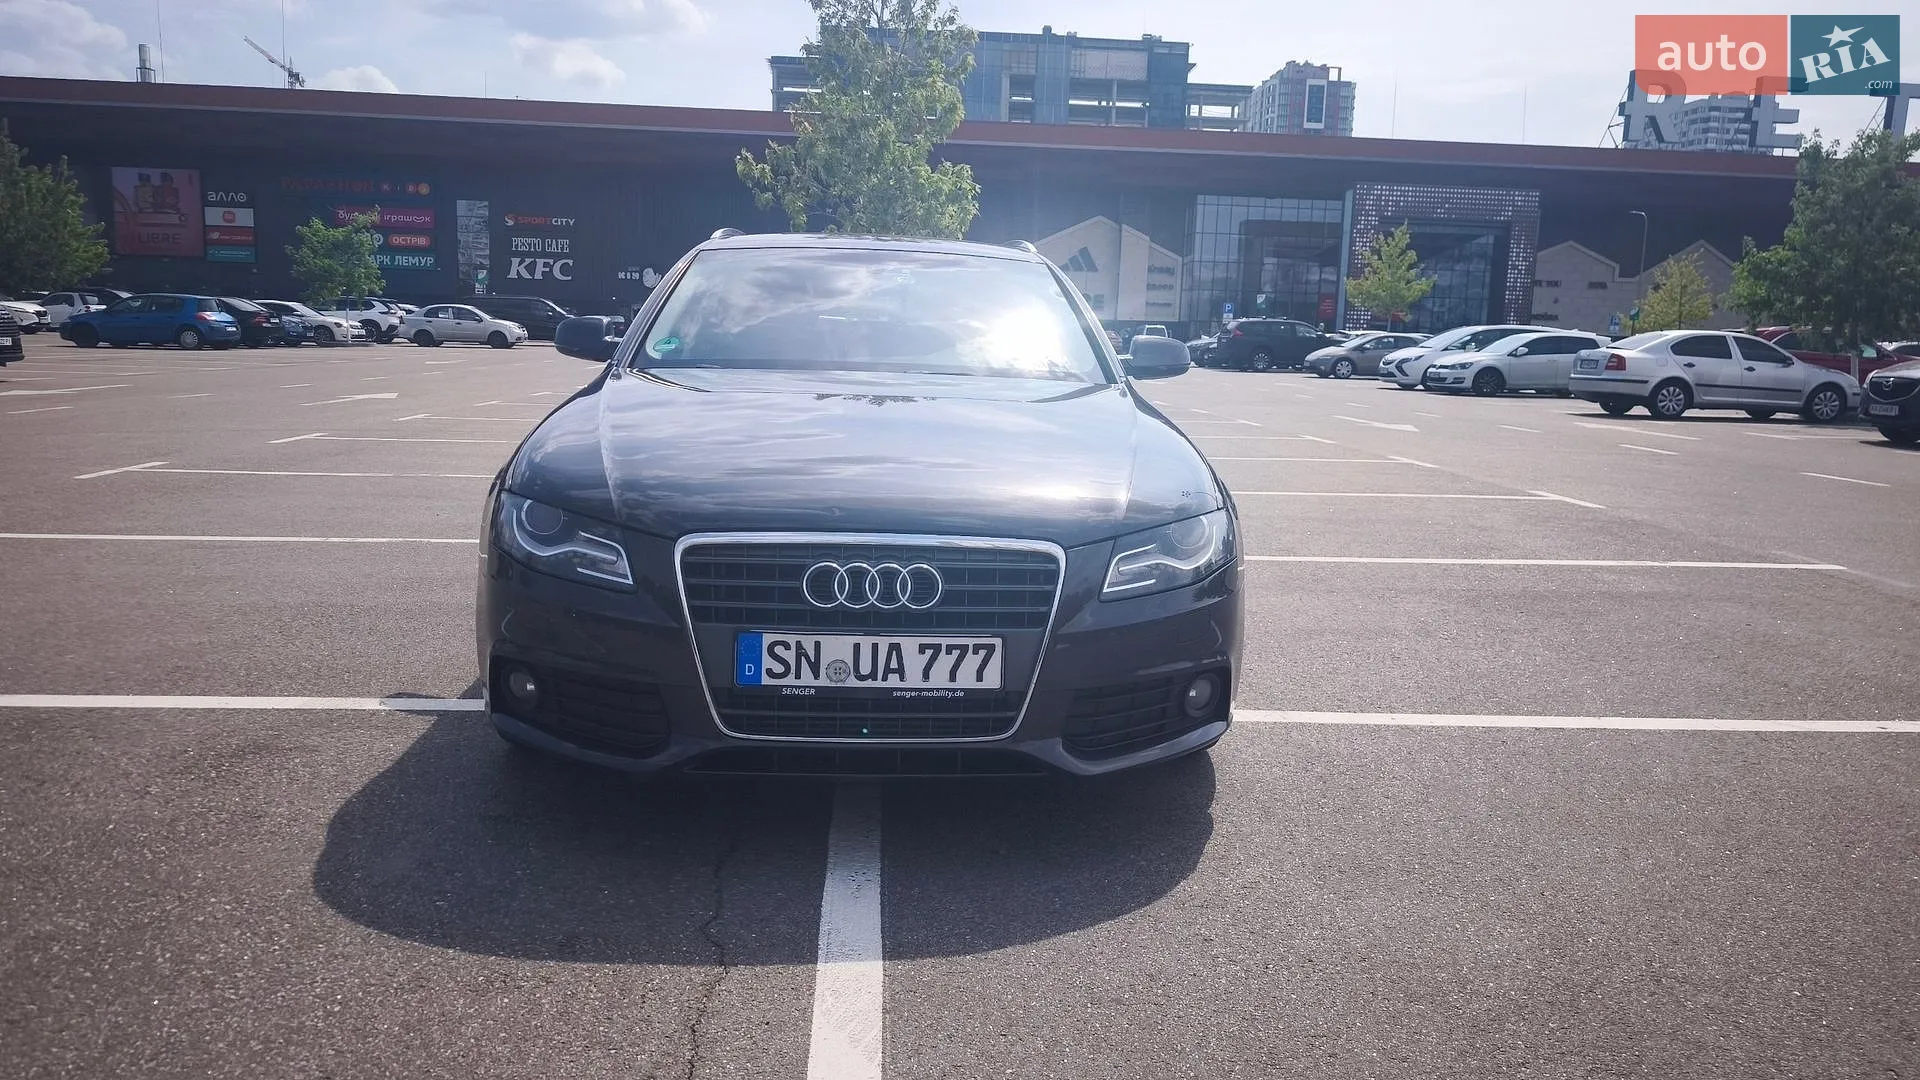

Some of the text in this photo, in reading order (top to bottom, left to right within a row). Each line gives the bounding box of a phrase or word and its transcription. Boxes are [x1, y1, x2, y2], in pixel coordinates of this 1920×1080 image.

[392, 234, 426, 246] ОСТРІВ
[512, 237, 569, 253] PESTO CAFE
[393, 255, 434, 267] ЛЕМУР
[506, 257, 574, 281] KFC
[744, 640, 996, 683] D SN UA 777
[781, 687, 965, 698] SENGER senger-mobility.de
